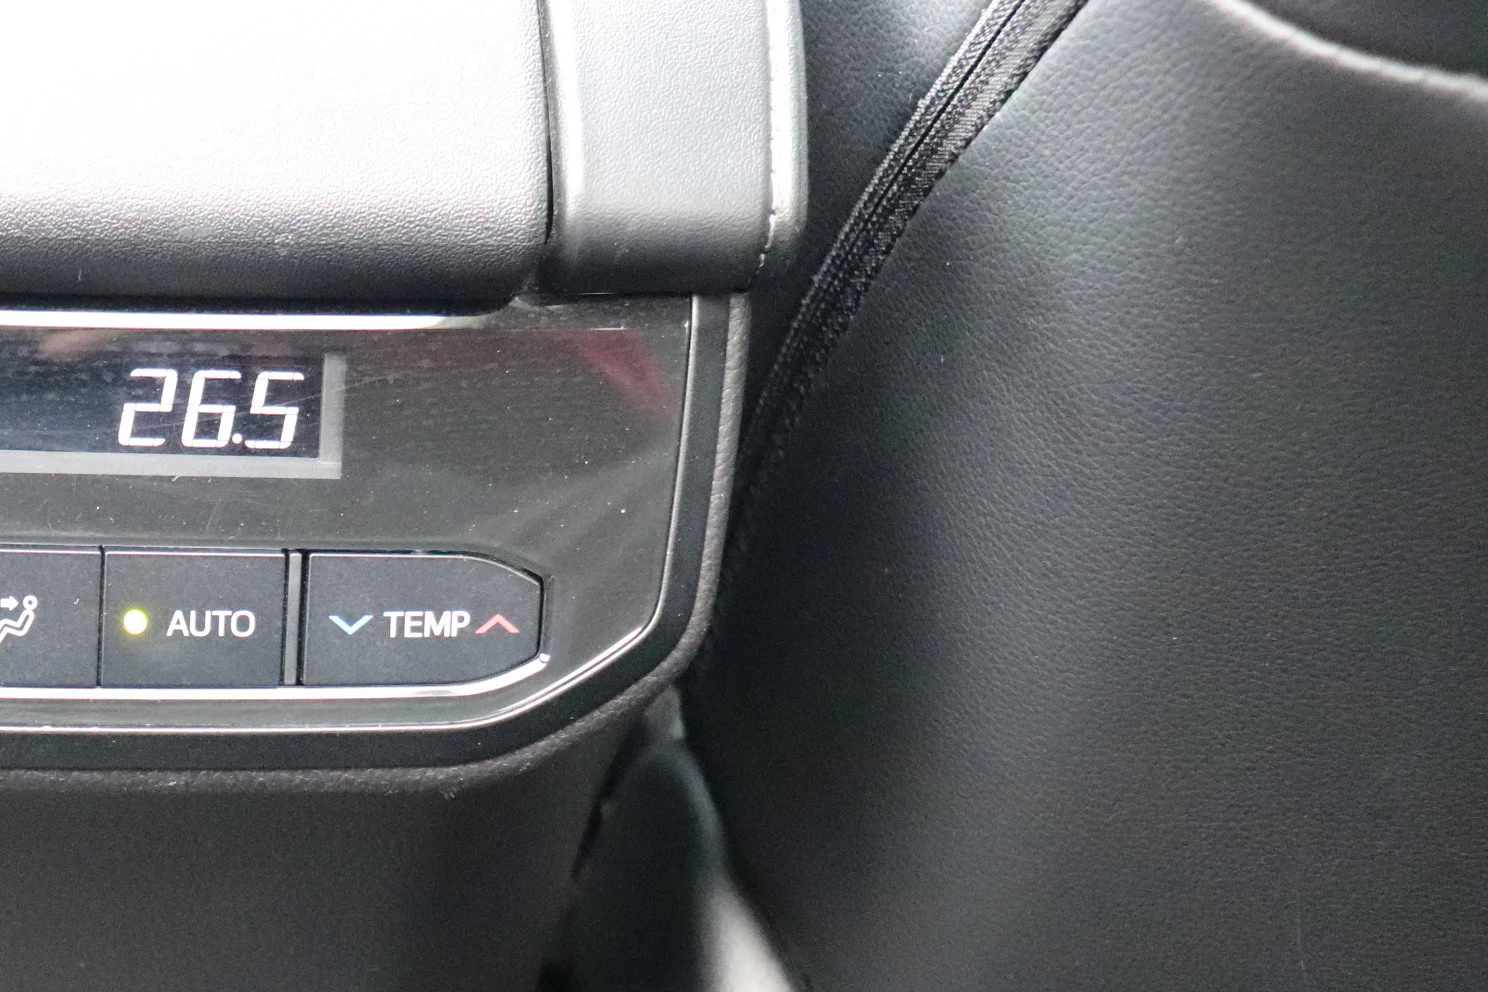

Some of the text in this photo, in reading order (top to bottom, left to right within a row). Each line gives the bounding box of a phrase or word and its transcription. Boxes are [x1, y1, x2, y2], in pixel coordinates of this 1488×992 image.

[118, 368, 304, 449] 26.5
[166, 609, 256, 637] AUTO
[383, 611, 470, 638] TEMP
